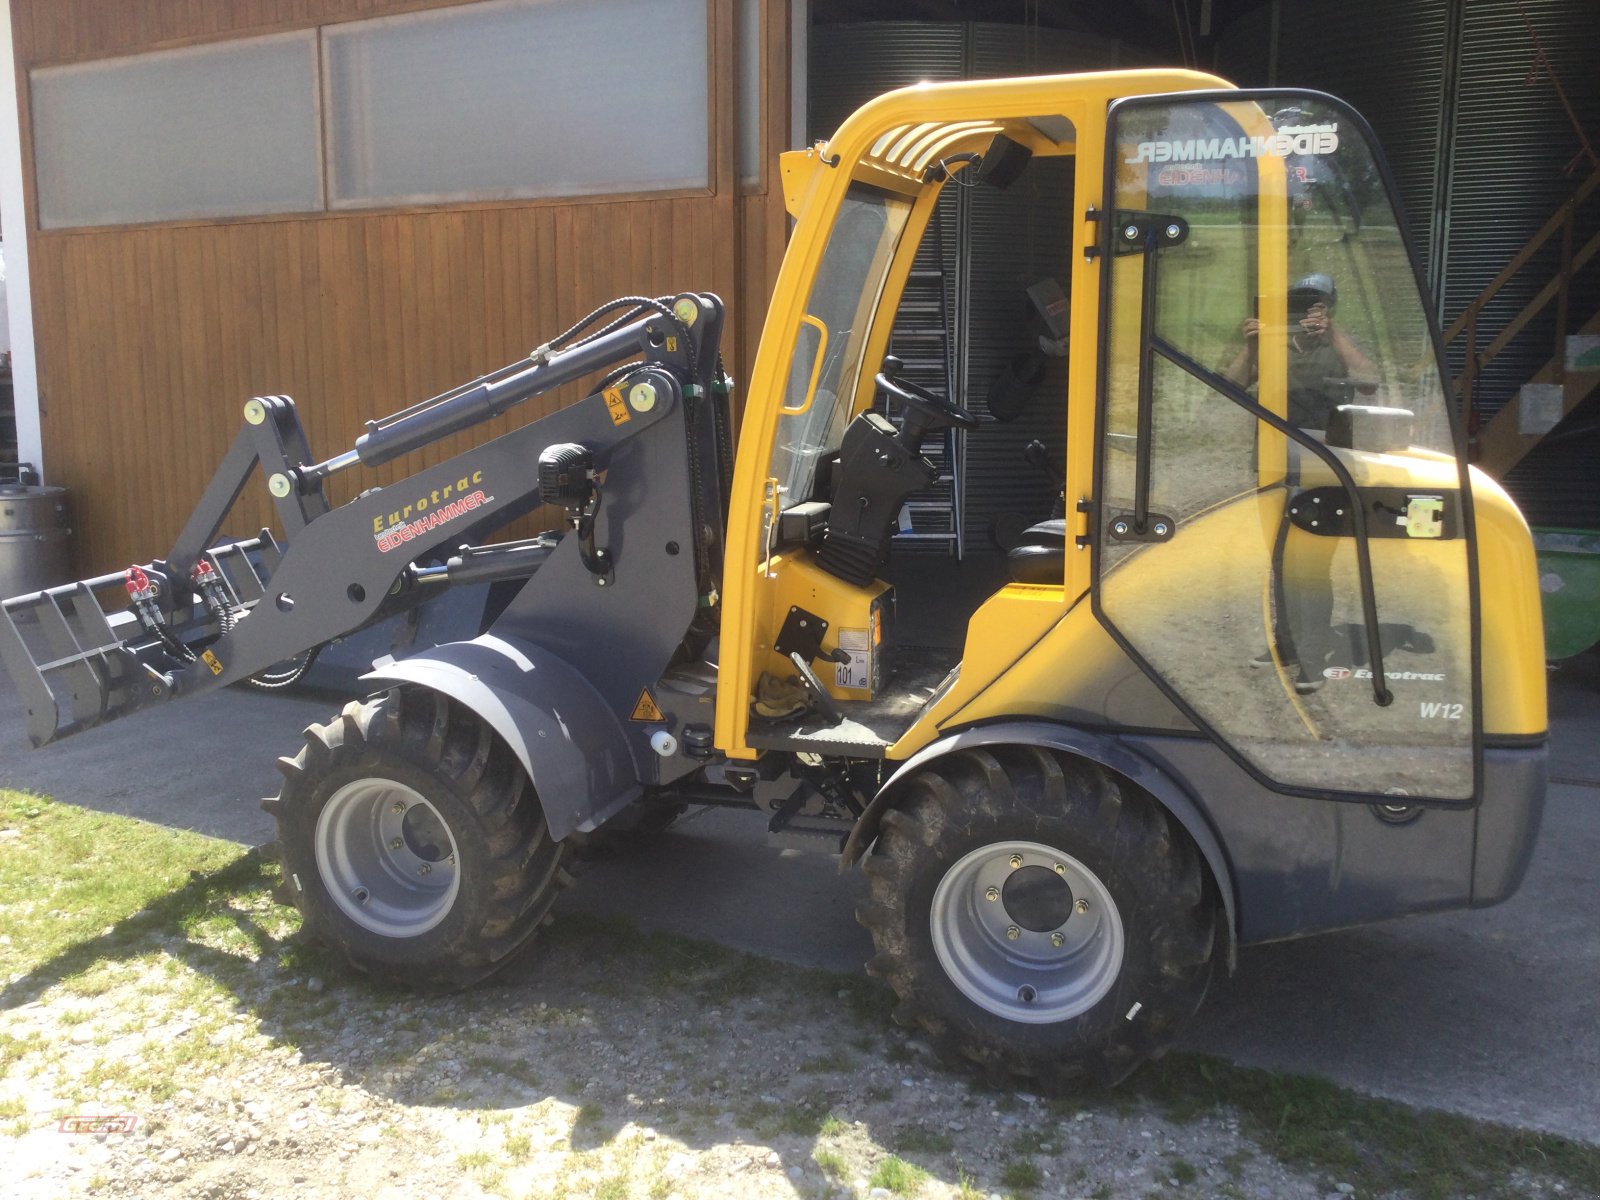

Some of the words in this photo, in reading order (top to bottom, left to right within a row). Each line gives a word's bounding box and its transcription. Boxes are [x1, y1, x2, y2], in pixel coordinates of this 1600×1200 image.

[373, 470, 483, 533] Eurotrac
[376, 490, 490, 553] EIDENHAMMER
[837, 666, 852, 685] 101
[1420, 702, 1464, 719] W12
